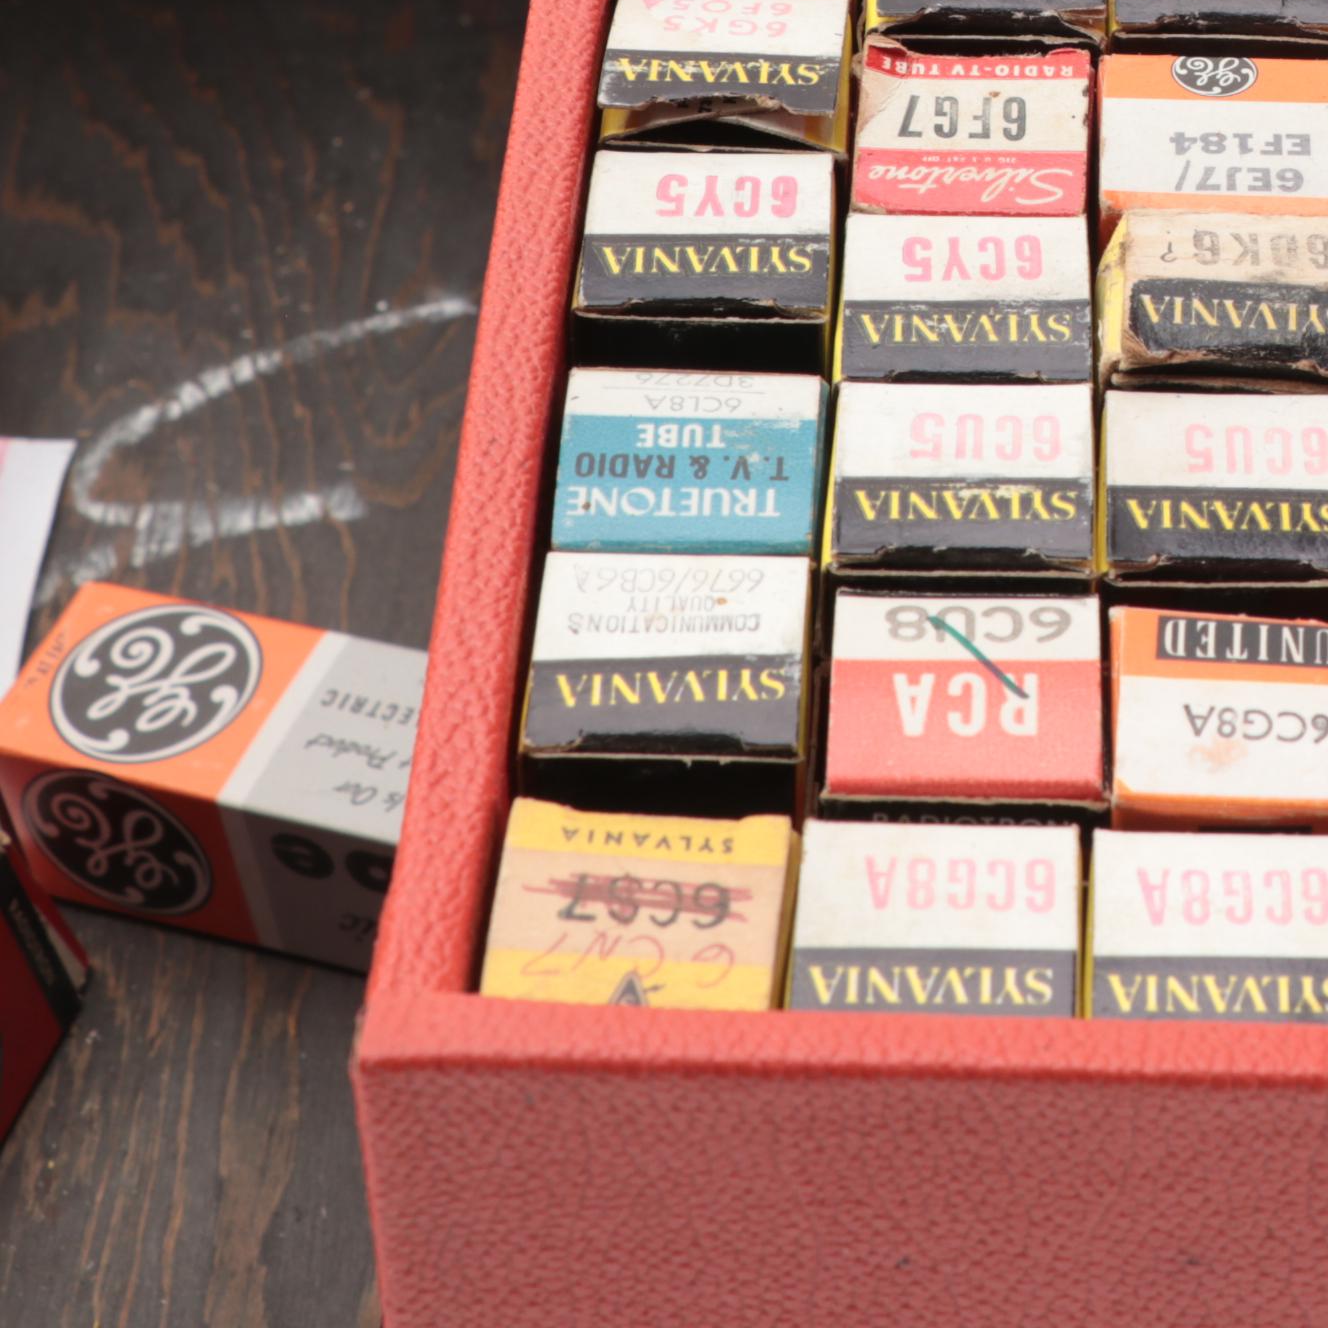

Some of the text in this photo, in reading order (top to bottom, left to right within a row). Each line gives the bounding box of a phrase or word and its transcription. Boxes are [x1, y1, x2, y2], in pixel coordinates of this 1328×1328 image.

[616, 56, 821, 87] SYLVANIA
[880, 55, 1075, 77] RADIO-TV TUBE
[896, 92, 1028, 143] 6FG7
[1168, 130, 1313, 158] EF184
[867, 163, 1075, 206] Silvertone
[1173, 159, 1306, 194] 6EJ7/
[654, 172, 801, 220] 6CY5
[600, 244, 815, 276] SYLVANIA
[899, 234, 1045, 283] 6CY5
[643, 394, 742, 414] 6CL8A
[634, 422, 728, 449] TUBE
[908, 412, 1063, 462] 6CU5
[573, 452, 677, 482] RADIO
[687, 455, 711, 481] &
[564, 484, 782, 518] TRUETONE
[855, 488, 1078, 522] SYLVANIA
[566, 610, 763, 636] COMMUNICATIONS
[555, 667, 787, 709] SYLVANIA
[892, 671, 1040, 739] RCA
[560, 826, 735, 855] SYLVANIA
[861, 854, 1058, 915] 6CG8A
[808, 963, 1056, 1007] SYLVANIA
